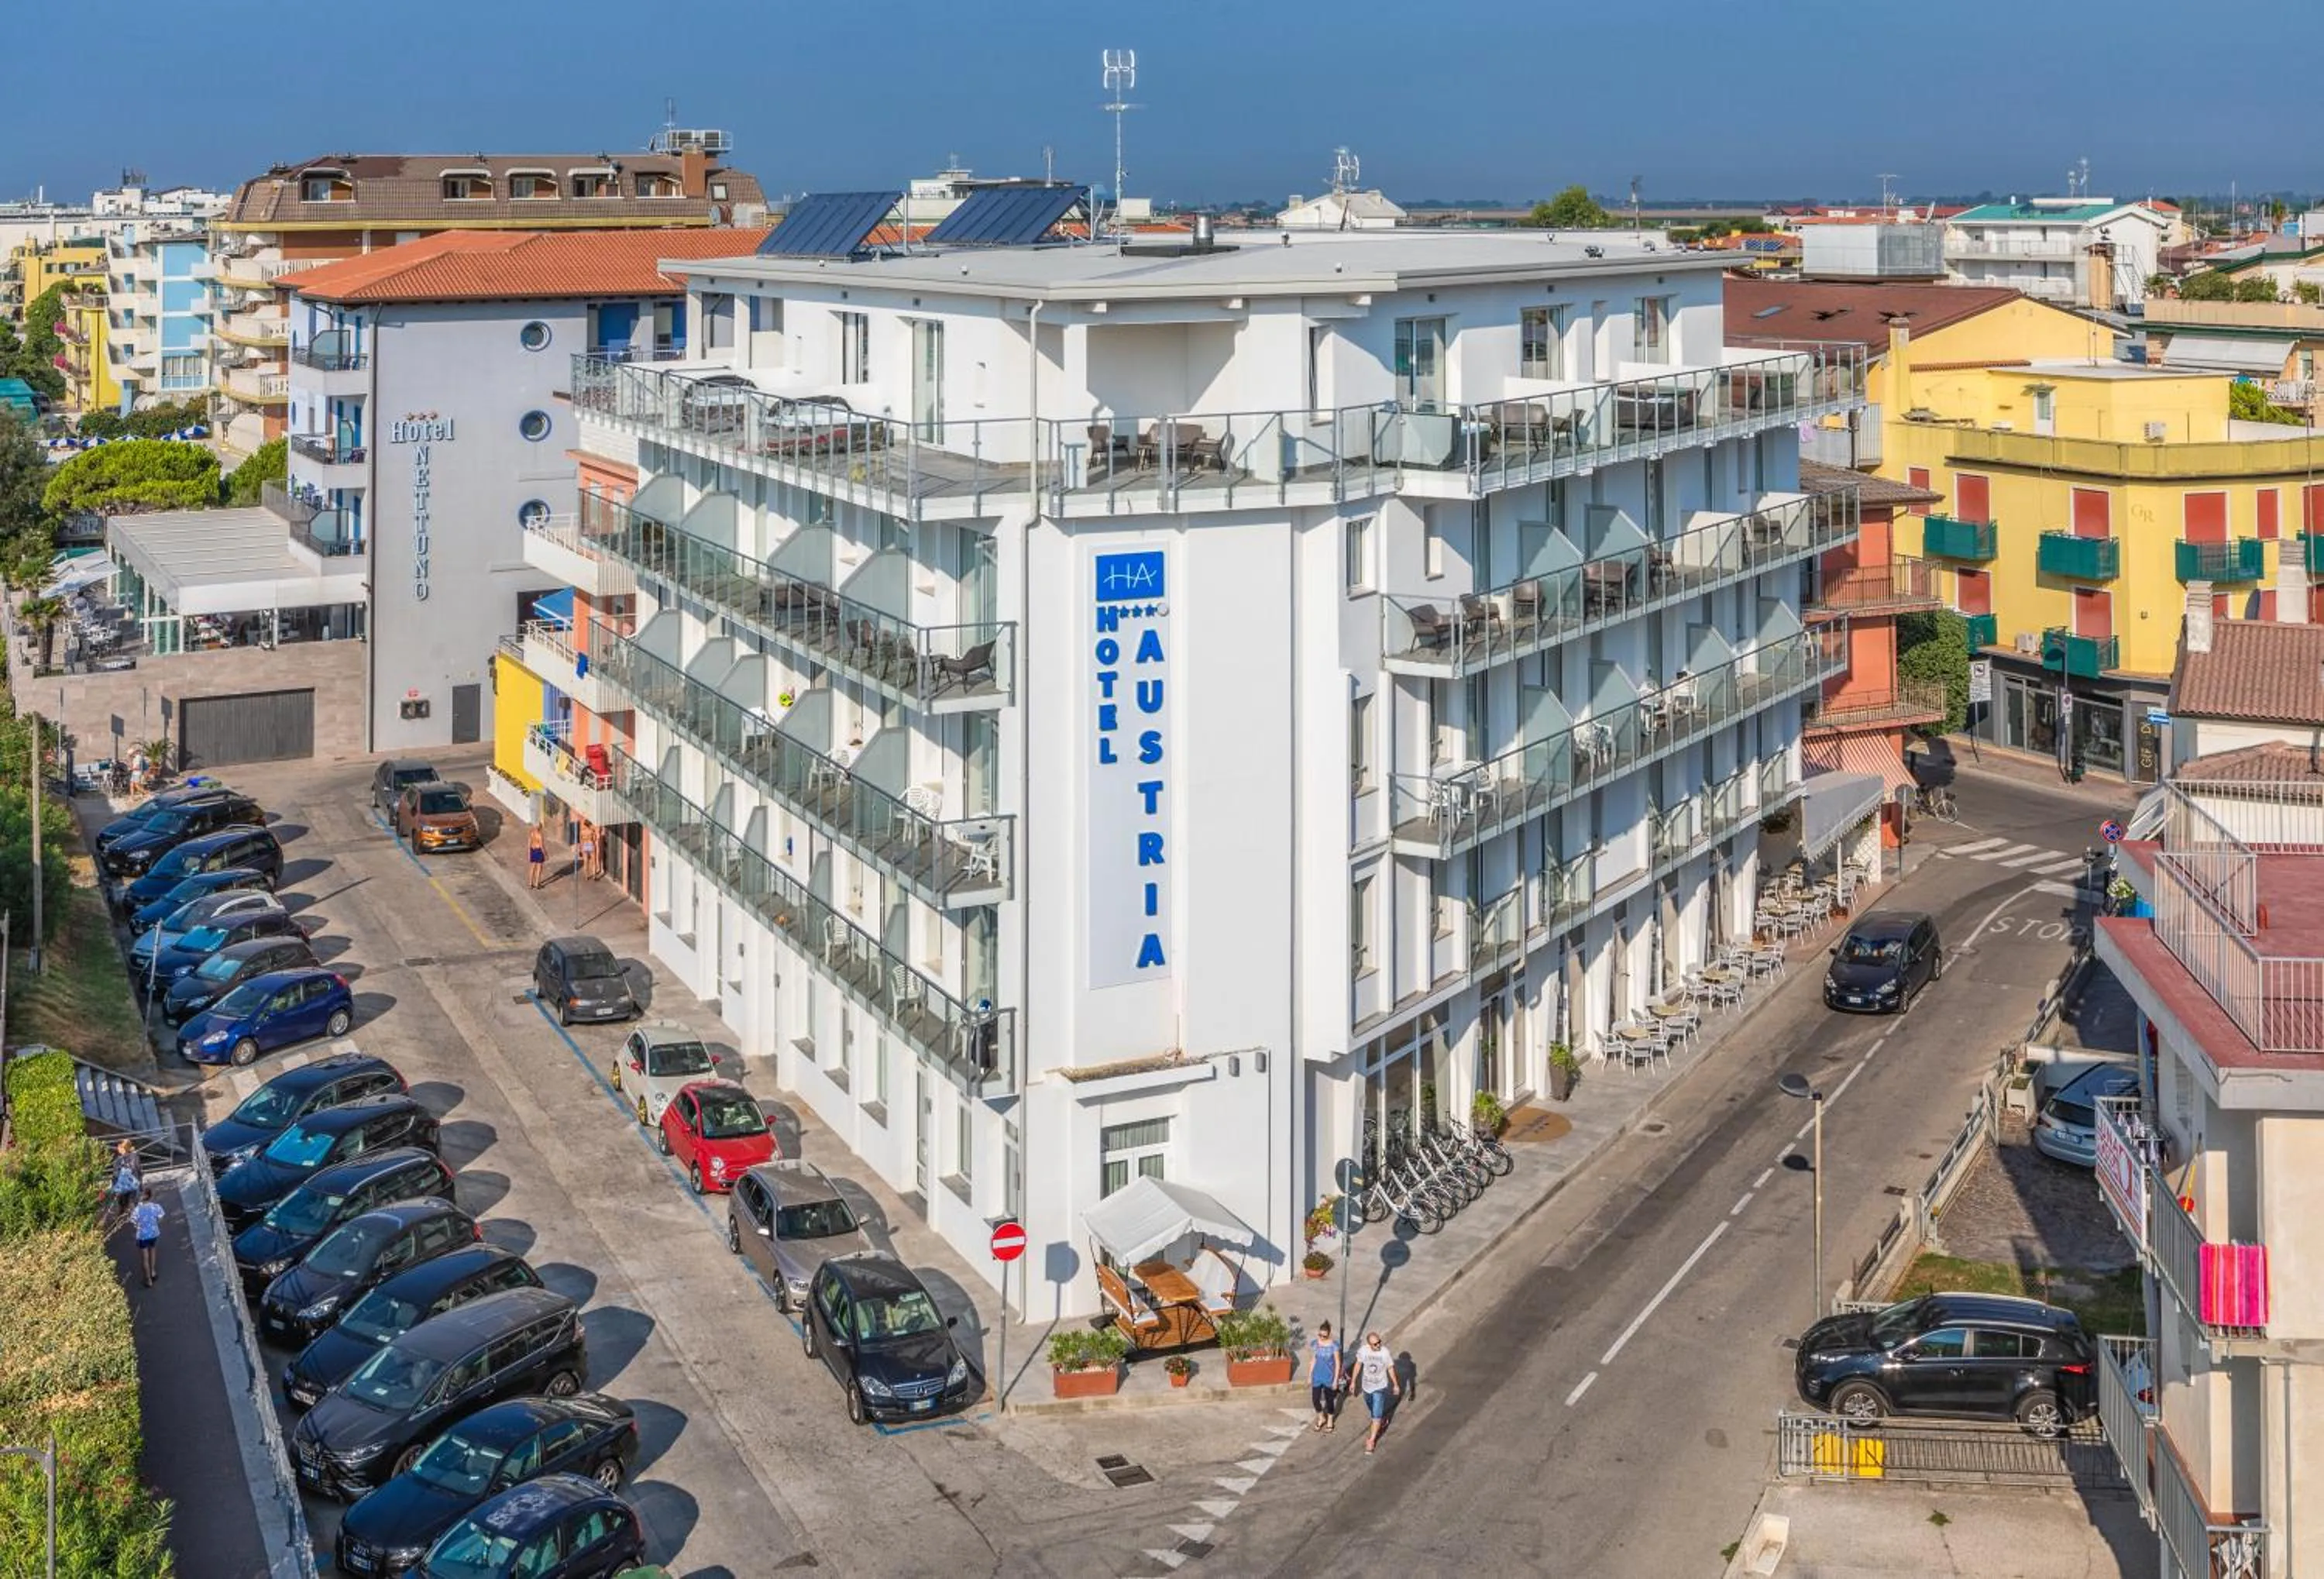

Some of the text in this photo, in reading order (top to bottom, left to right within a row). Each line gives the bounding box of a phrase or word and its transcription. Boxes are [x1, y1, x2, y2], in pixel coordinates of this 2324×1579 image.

[390, 417, 455, 443] Hotel
[414, 445, 430, 601] NETTUNO
[1102, 562, 1157, 590] HA
[1095, 605, 1119, 764] HOTEL
[1136, 629, 1165, 968] AUSTRIA
[1989, 917, 2087, 941] STOP
